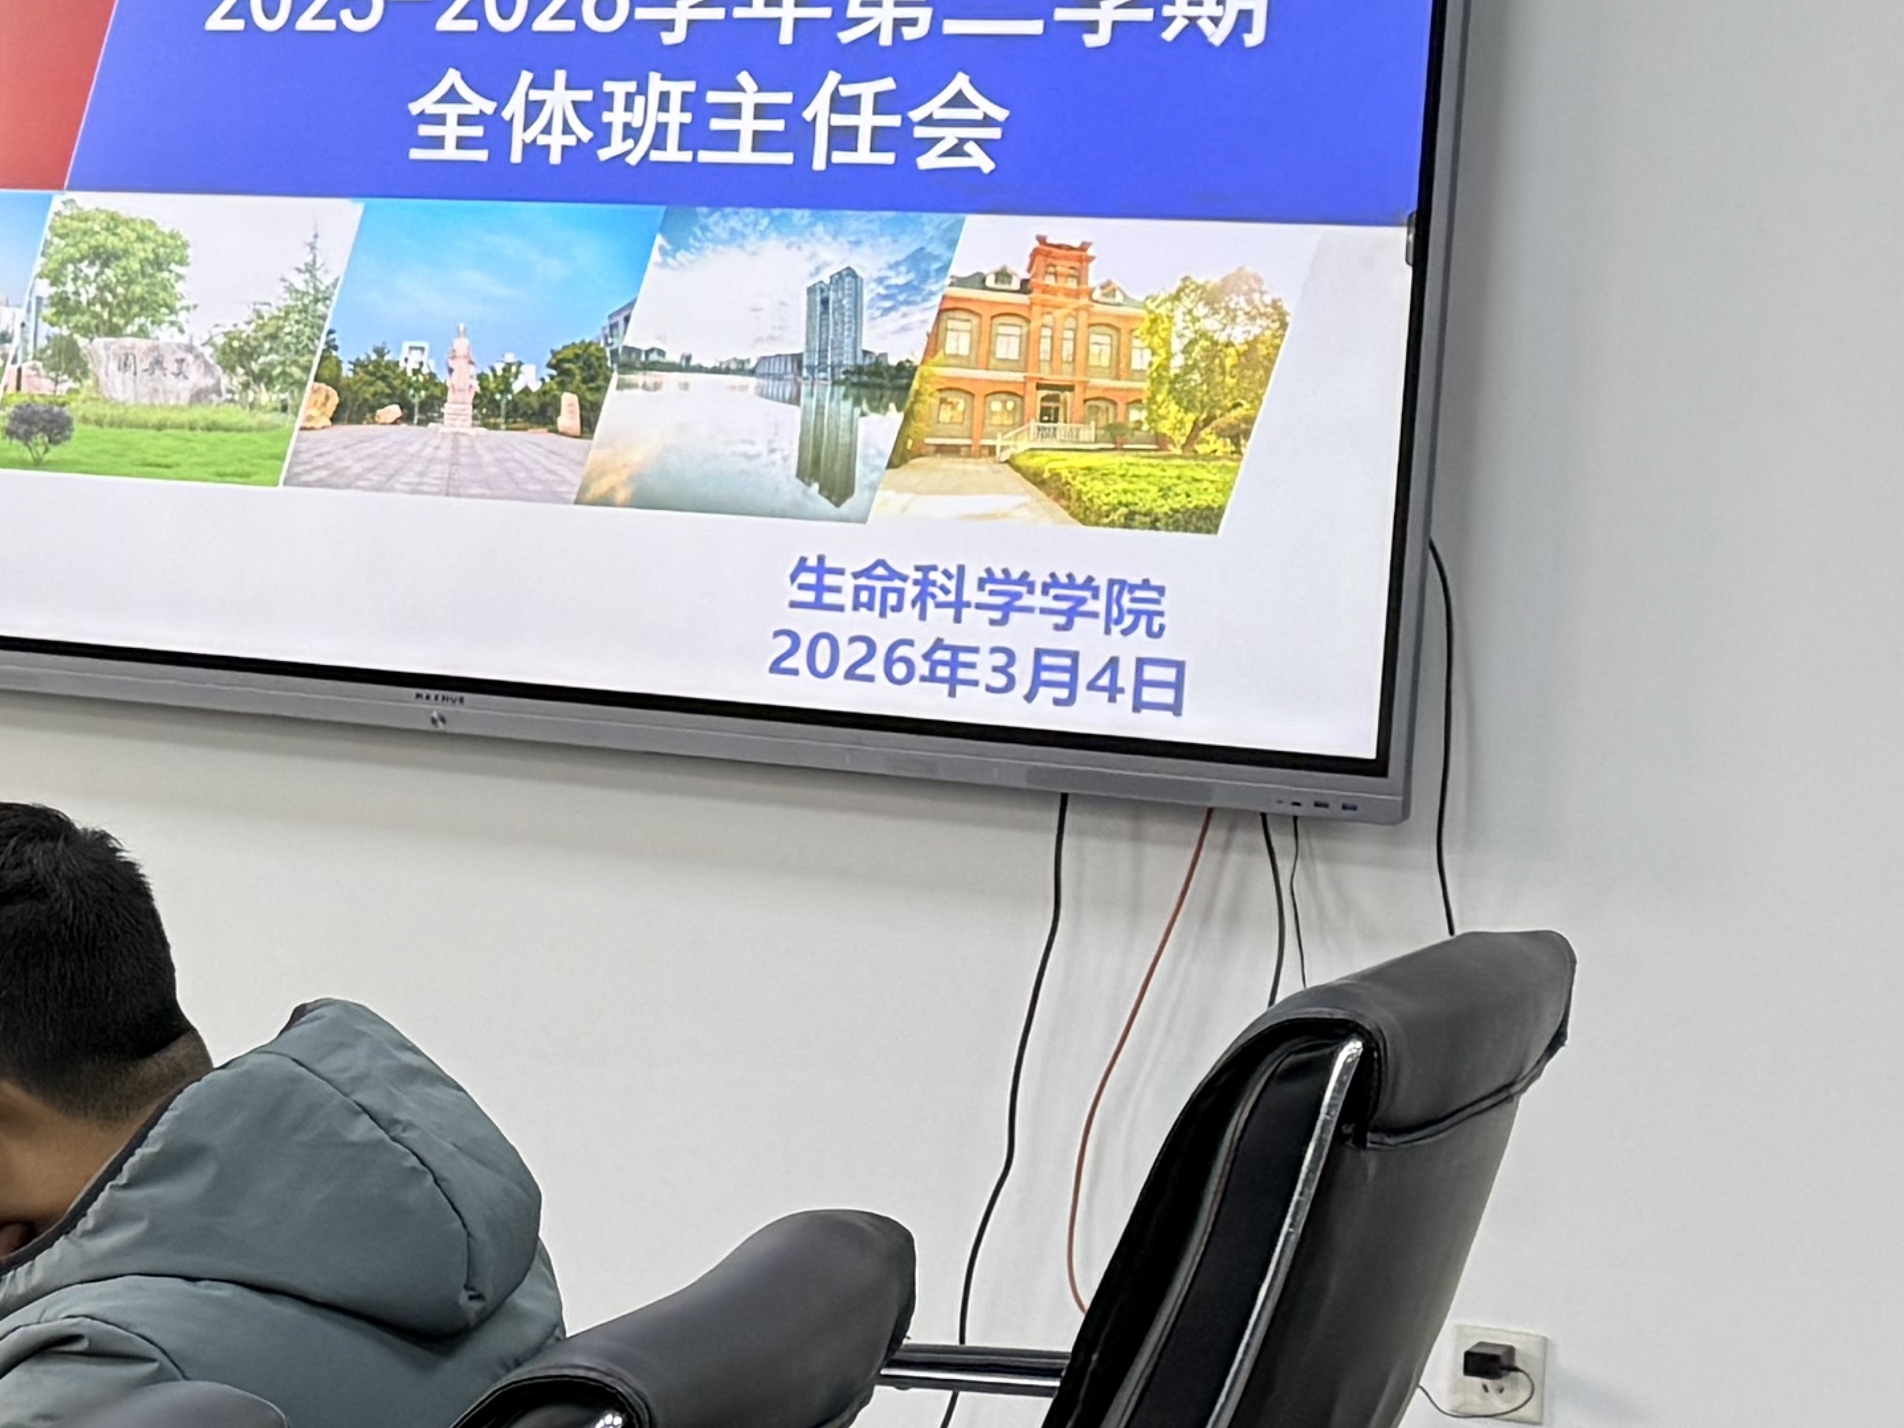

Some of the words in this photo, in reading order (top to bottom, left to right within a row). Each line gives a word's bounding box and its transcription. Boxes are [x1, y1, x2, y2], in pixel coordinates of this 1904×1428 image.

[406, 66, 1010, 174] 全体班主任会
[788, 554, 1167, 640] 生命科学学院
[768, 628, 1187, 718] 2026年3月4日
